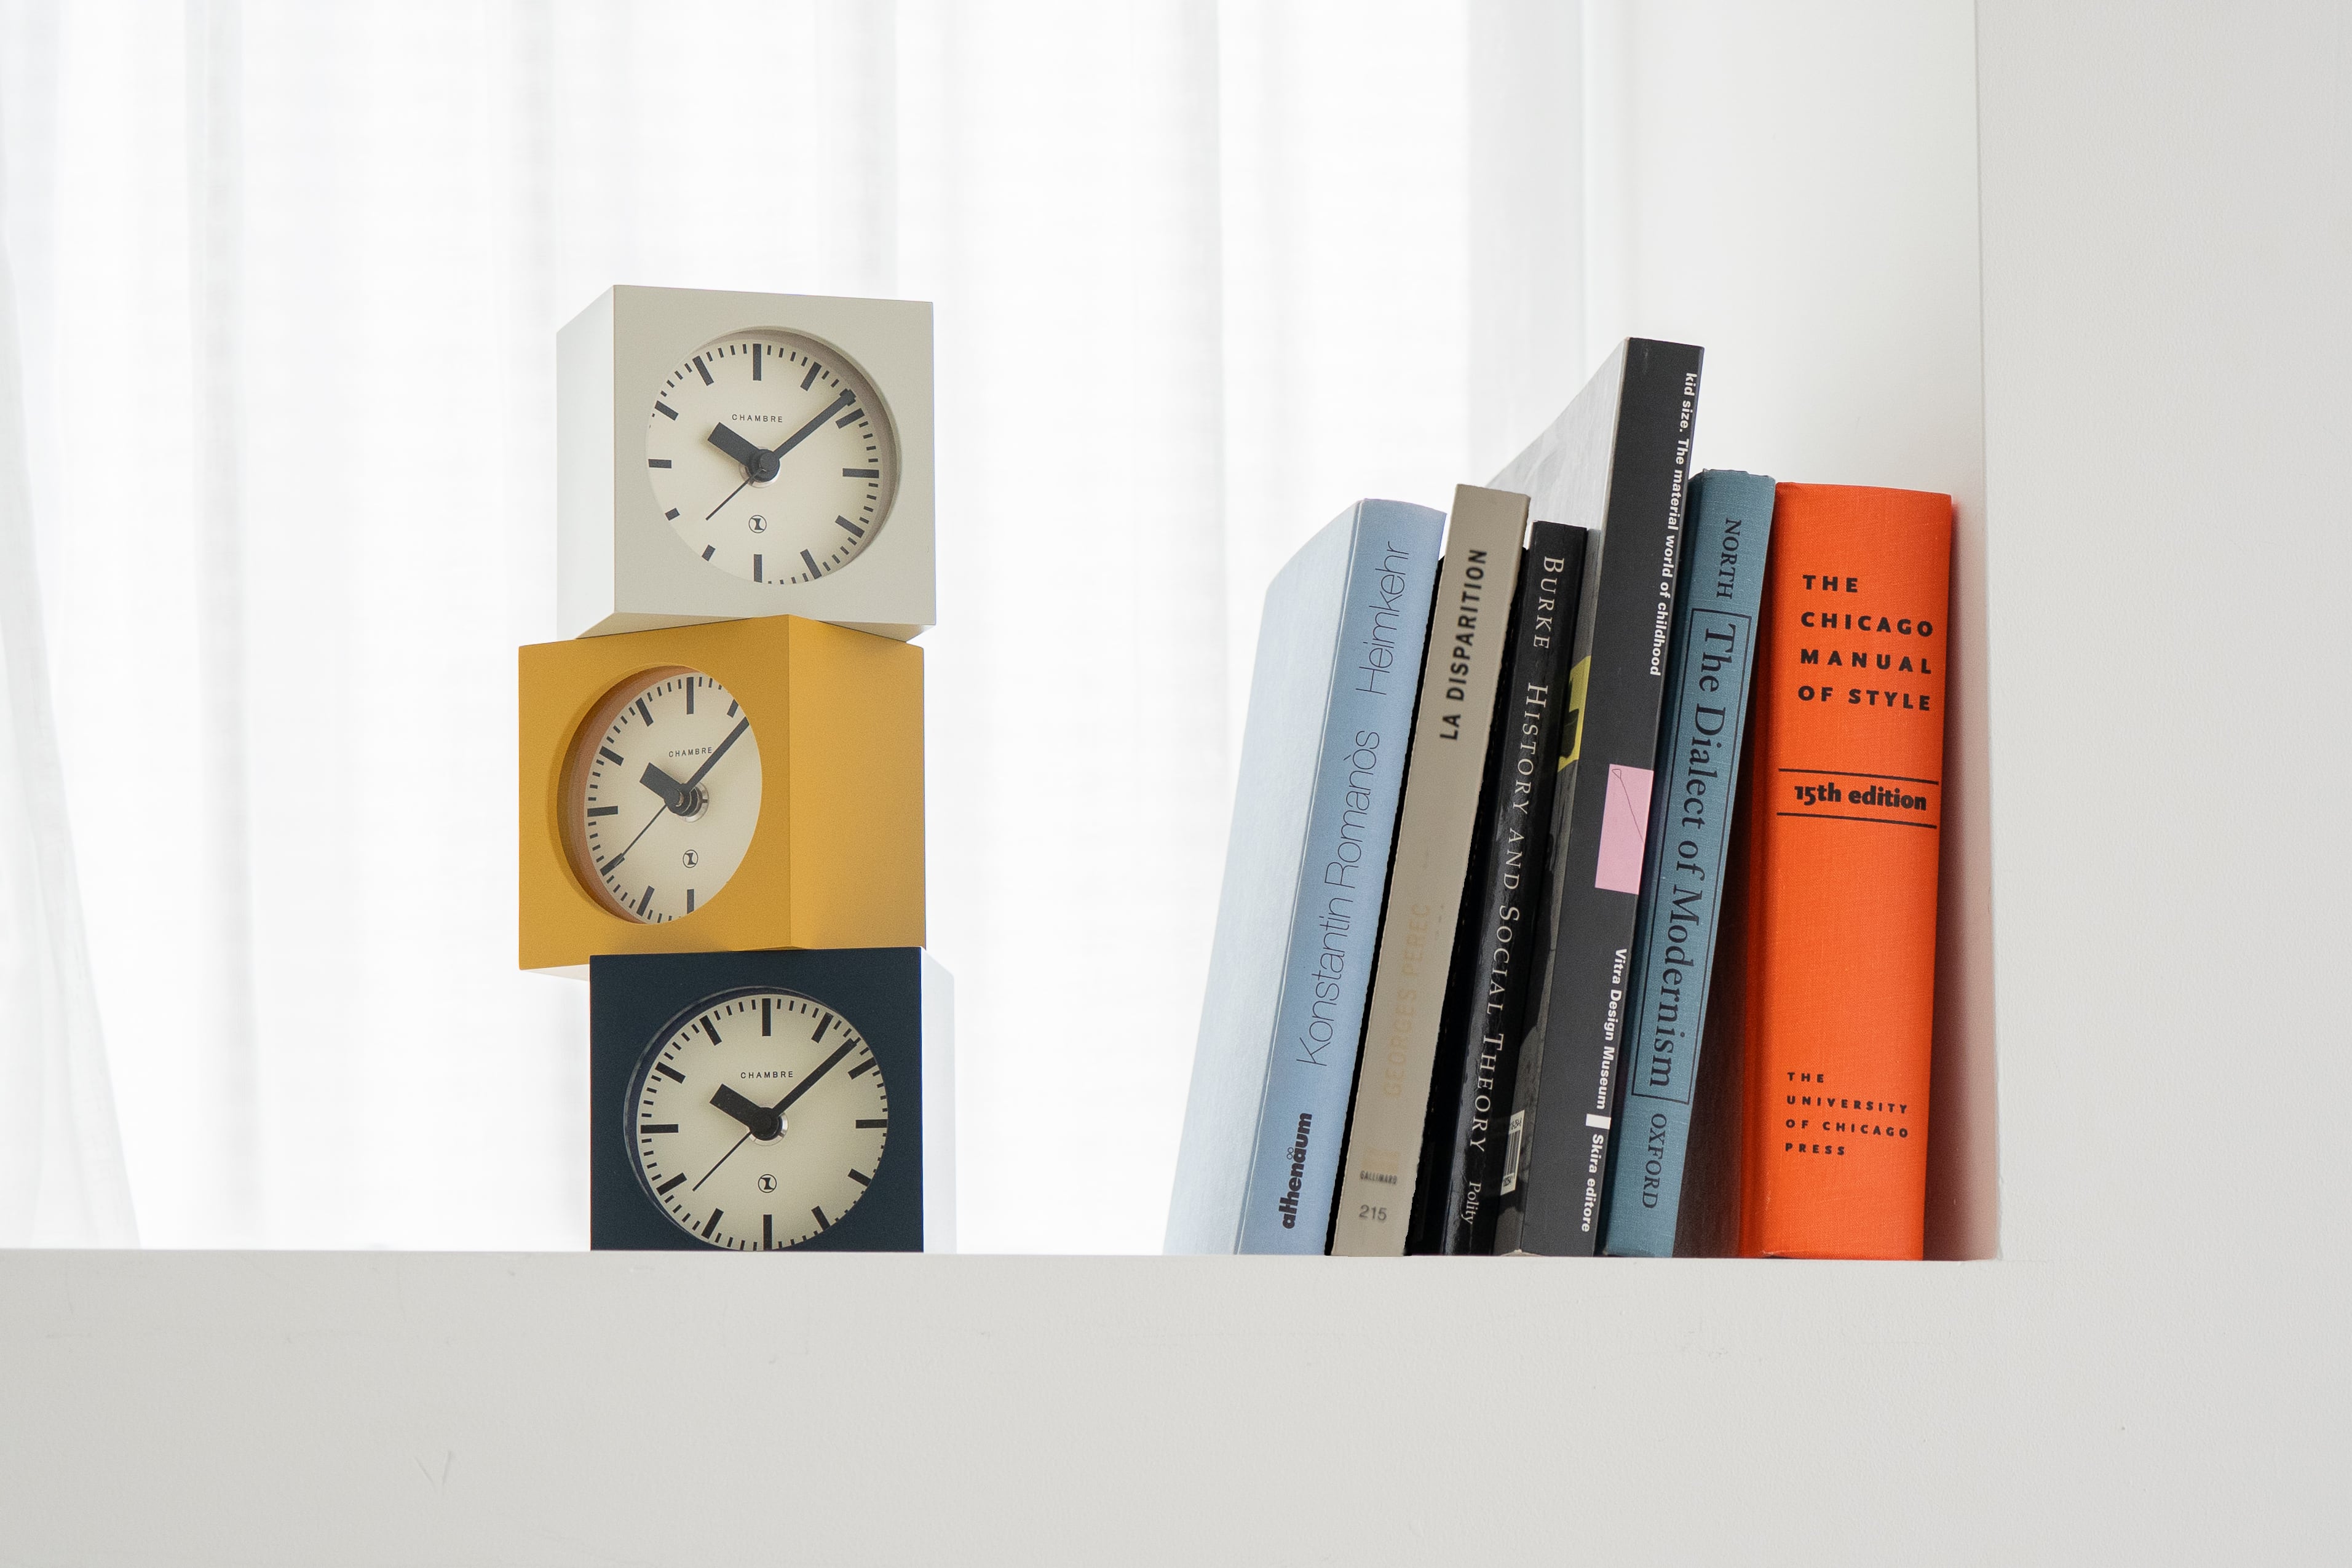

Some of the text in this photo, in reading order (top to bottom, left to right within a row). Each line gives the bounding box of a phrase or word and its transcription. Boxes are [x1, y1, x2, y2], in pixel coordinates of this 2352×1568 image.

[1650, 373, 1697, 675] kid size. The material world of childhood
[1717, 518, 1741, 599] NORTH
[1803, 575, 1858, 593] THE
[1534, 556, 1564, 648] BURKE
[1801, 612, 1933, 636] CHICAGO
[1440, 550, 1487, 740] LA DISPARITION
[1801, 649, 1931, 674] MANUAL
[1798, 686, 1930, 711] OF STYLE
[669, 747, 711, 757] CHAMBRE
[1296, 541, 1409, 1066] Konstantin Romanòs Heimkehr
[1794, 782, 1926, 810] 15th edition
[1650, 624, 1736, 1087] The Dialect of Modernism
[1470, 683, 1548, 1151] HISTORY AND SOCIAL THEORY
[1597, 949, 1627, 1109] Vitra Design Museum
[1788, 1072, 1824, 1083] THE
[1787, 1096, 1907, 1114] UNIVERSITY
[1786, 1119, 1907, 1138] OF CHICAGO
[1642, 1114, 1666, 1208] OXFORD
[1786, 1143, 1844, 1155] PRESS
[1582, 1134, 1604, 1232] Skira editore
[1359, 1205, 1387, 1221] 215
[1462, 1182, 1481, 1224] Polity
